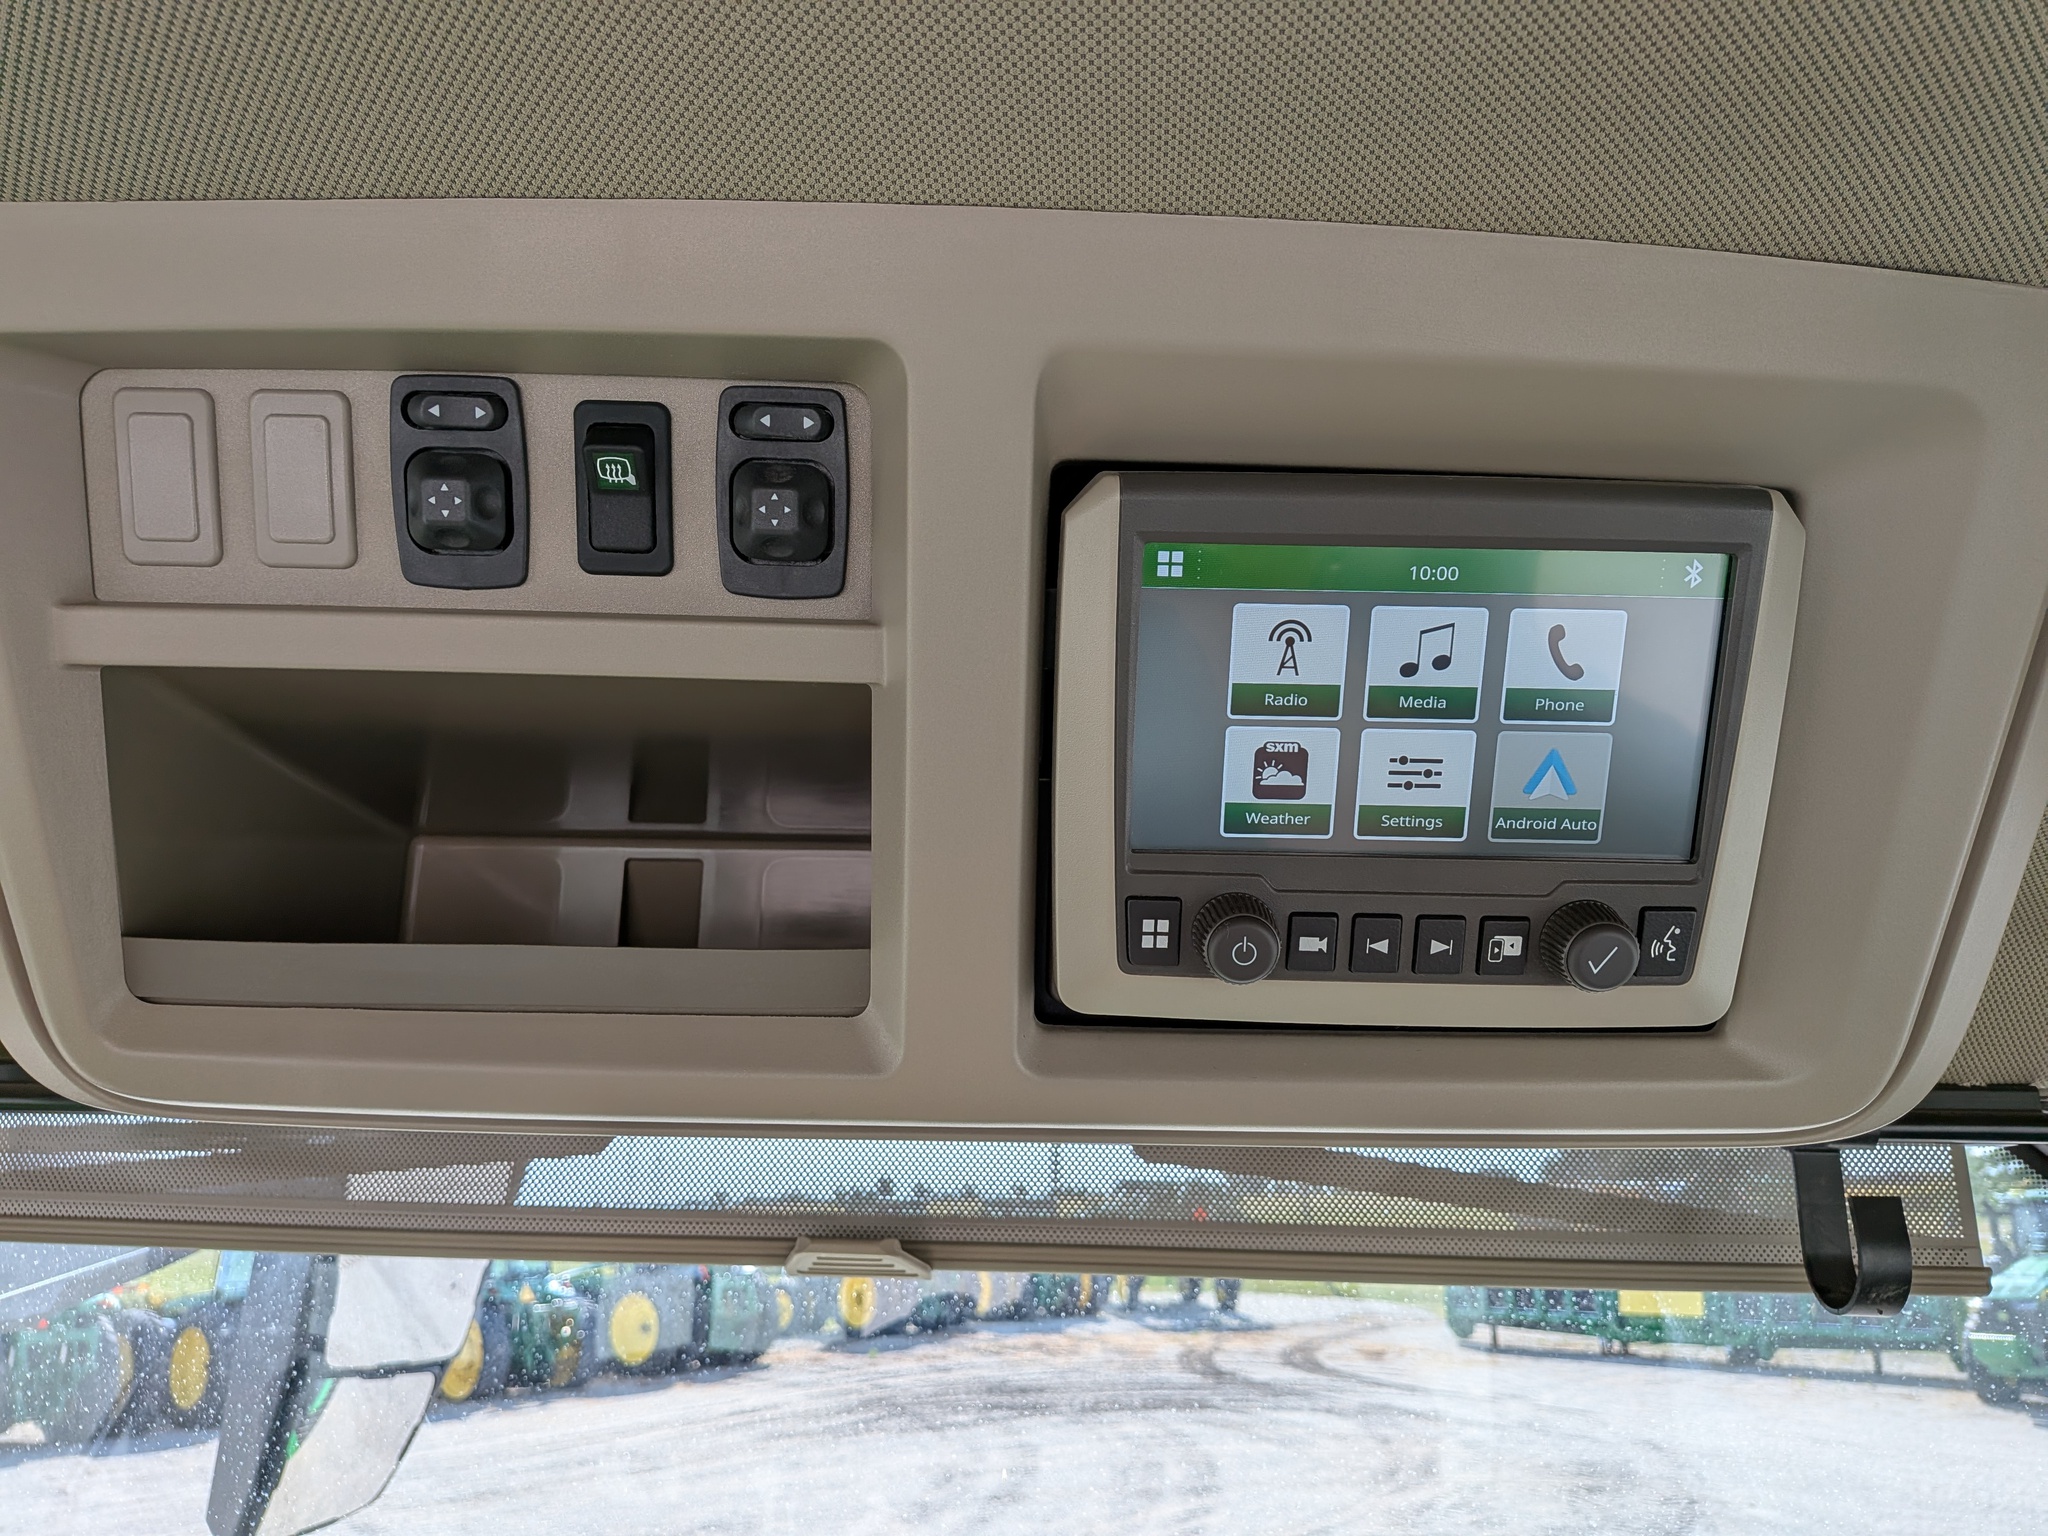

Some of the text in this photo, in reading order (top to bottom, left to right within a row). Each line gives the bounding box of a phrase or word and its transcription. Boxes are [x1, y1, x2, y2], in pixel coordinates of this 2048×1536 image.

[1409, 565, 1460, 582] 10:00
[1264, 692, 1309, 708] Radio
[1398, 694, 1447, 710] Media
[1534, 697, 1585, 712] Phone
[1244, 810, 1311, 827] Weather
[1380, 813, 1444, 831] Settings
[1494, 815, 1598, 832] Android Auto
